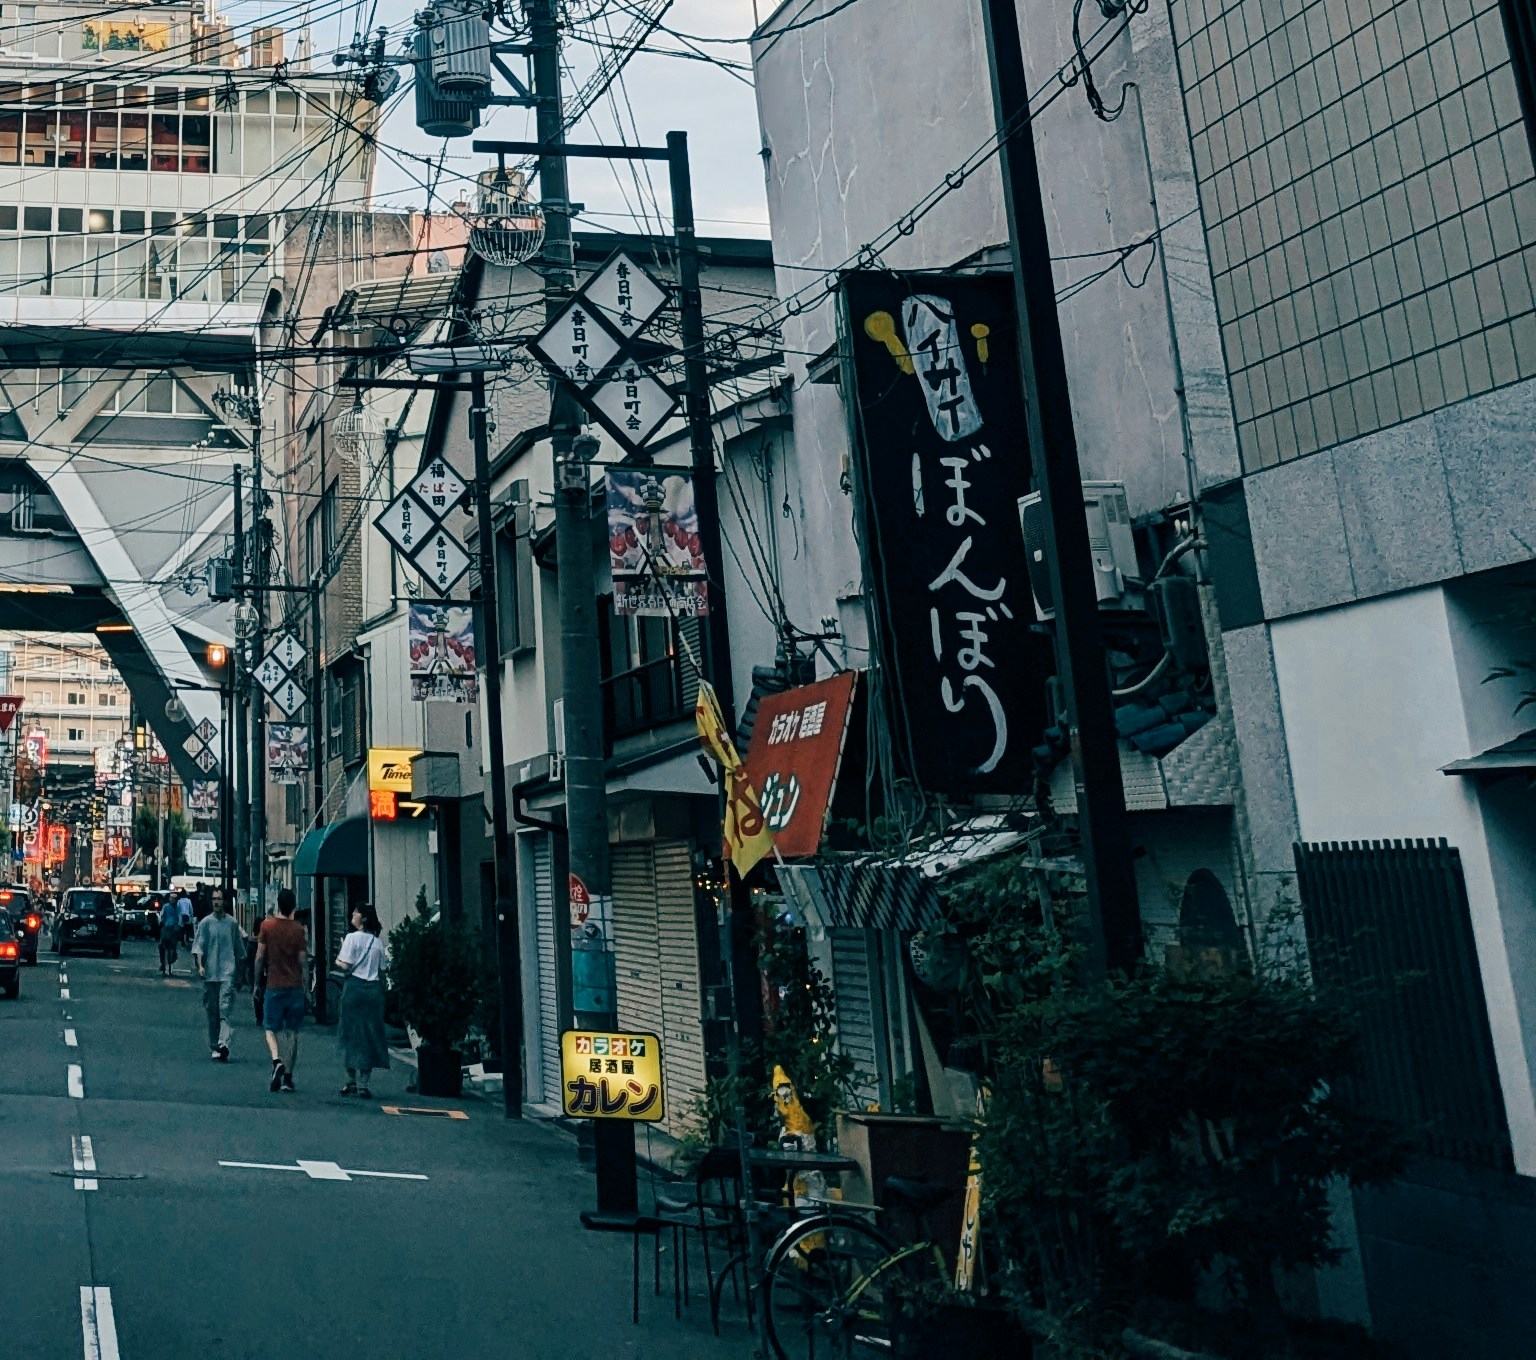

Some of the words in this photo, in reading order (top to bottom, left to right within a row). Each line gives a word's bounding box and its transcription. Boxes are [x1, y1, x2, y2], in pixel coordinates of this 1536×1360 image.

[615, 262, 635, 328] 春日町会
[571, 310, 590, 377] 春日町会
[908, 302, 964, 434] ハイサイ
[624, 369, 642, 432] 春日町会
[419, 482, 458, 493] たばこ
[402, 499, 412, 545] 春日町会
[436, 536, 448, 584] 春日町会
[912, 445, 1013, 775] ぼんぼり
[768, 711, 800, 745] カラオケ
[381, 764, 412, 780] Time
[577, 1037, 644, 1055] カラオケ
[590, 1059, 634, 1074] 居酒屋
[568, 1076, 658, 1114] カレン
